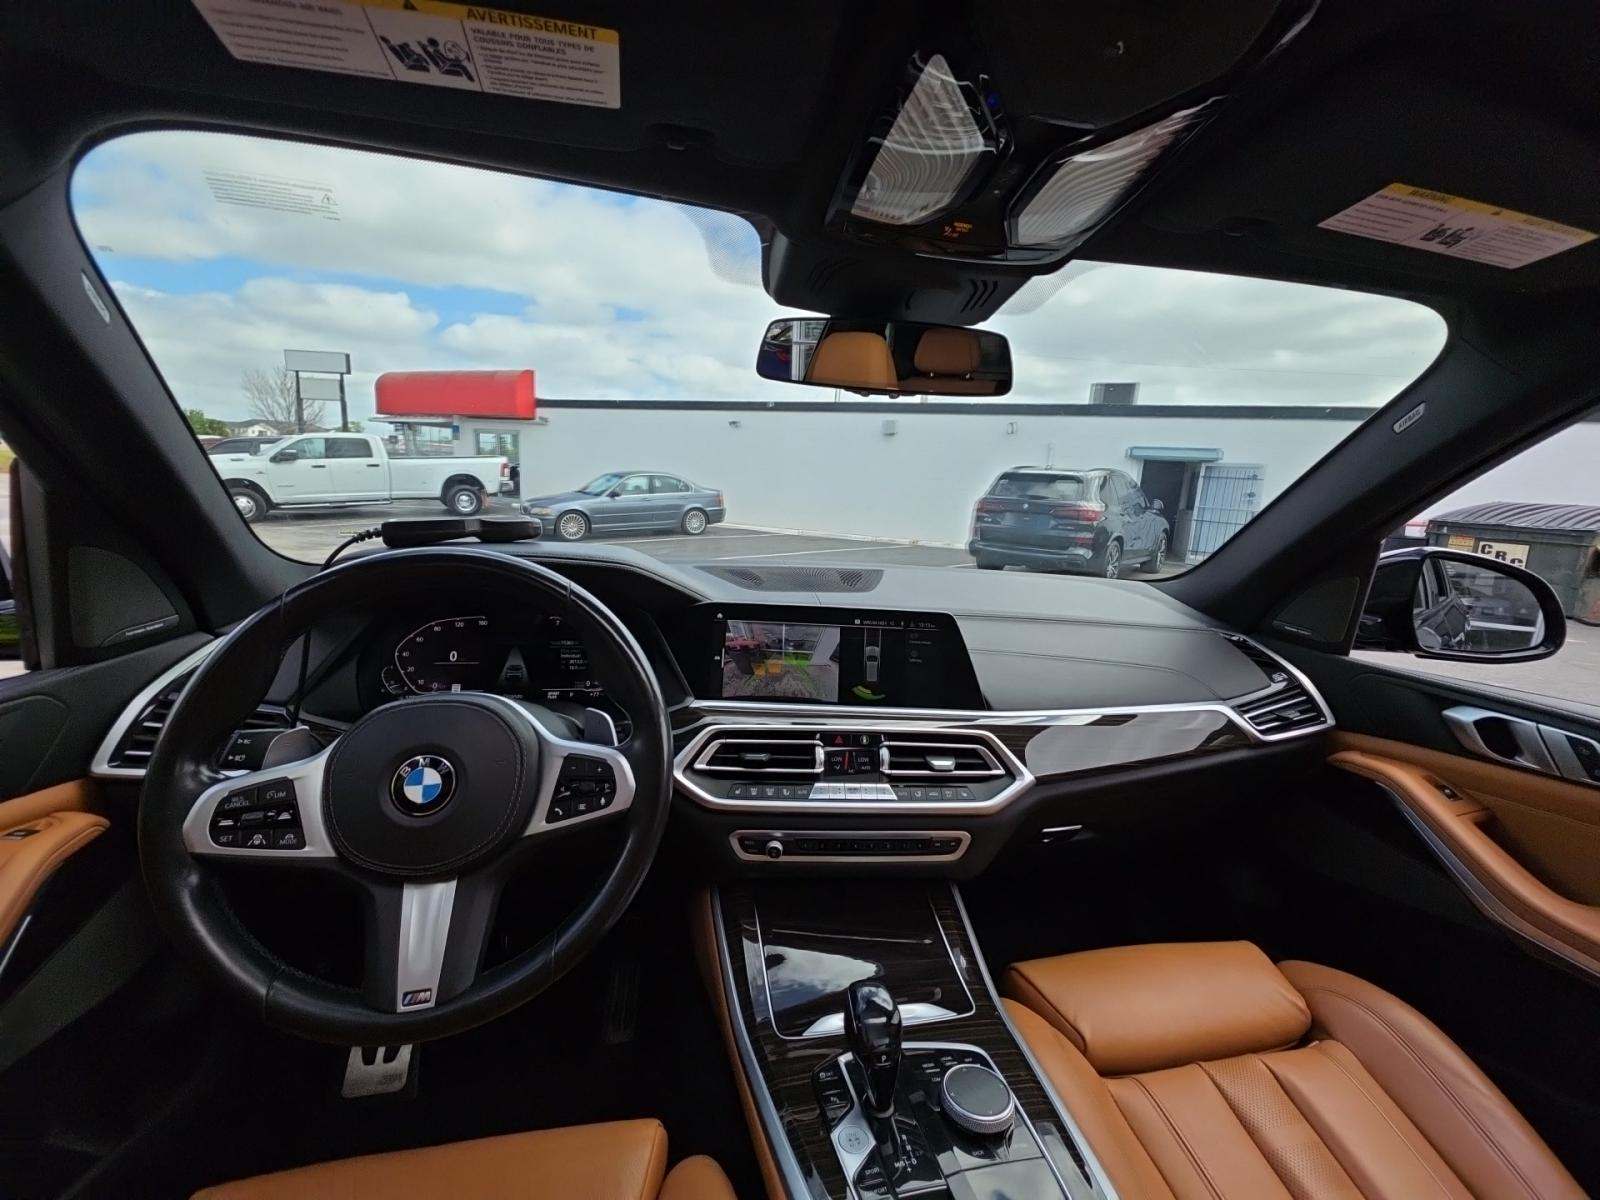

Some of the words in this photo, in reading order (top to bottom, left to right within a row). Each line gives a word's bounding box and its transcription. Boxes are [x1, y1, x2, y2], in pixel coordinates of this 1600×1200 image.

[466, 7, 598, 40] AVERTISSEMENT
[449, 650, 459, 662] 0
[400, 757, 452, 778] BMW
[225, 801, 250, 810] CANCEL
[220, 835, 234, 843] SET
